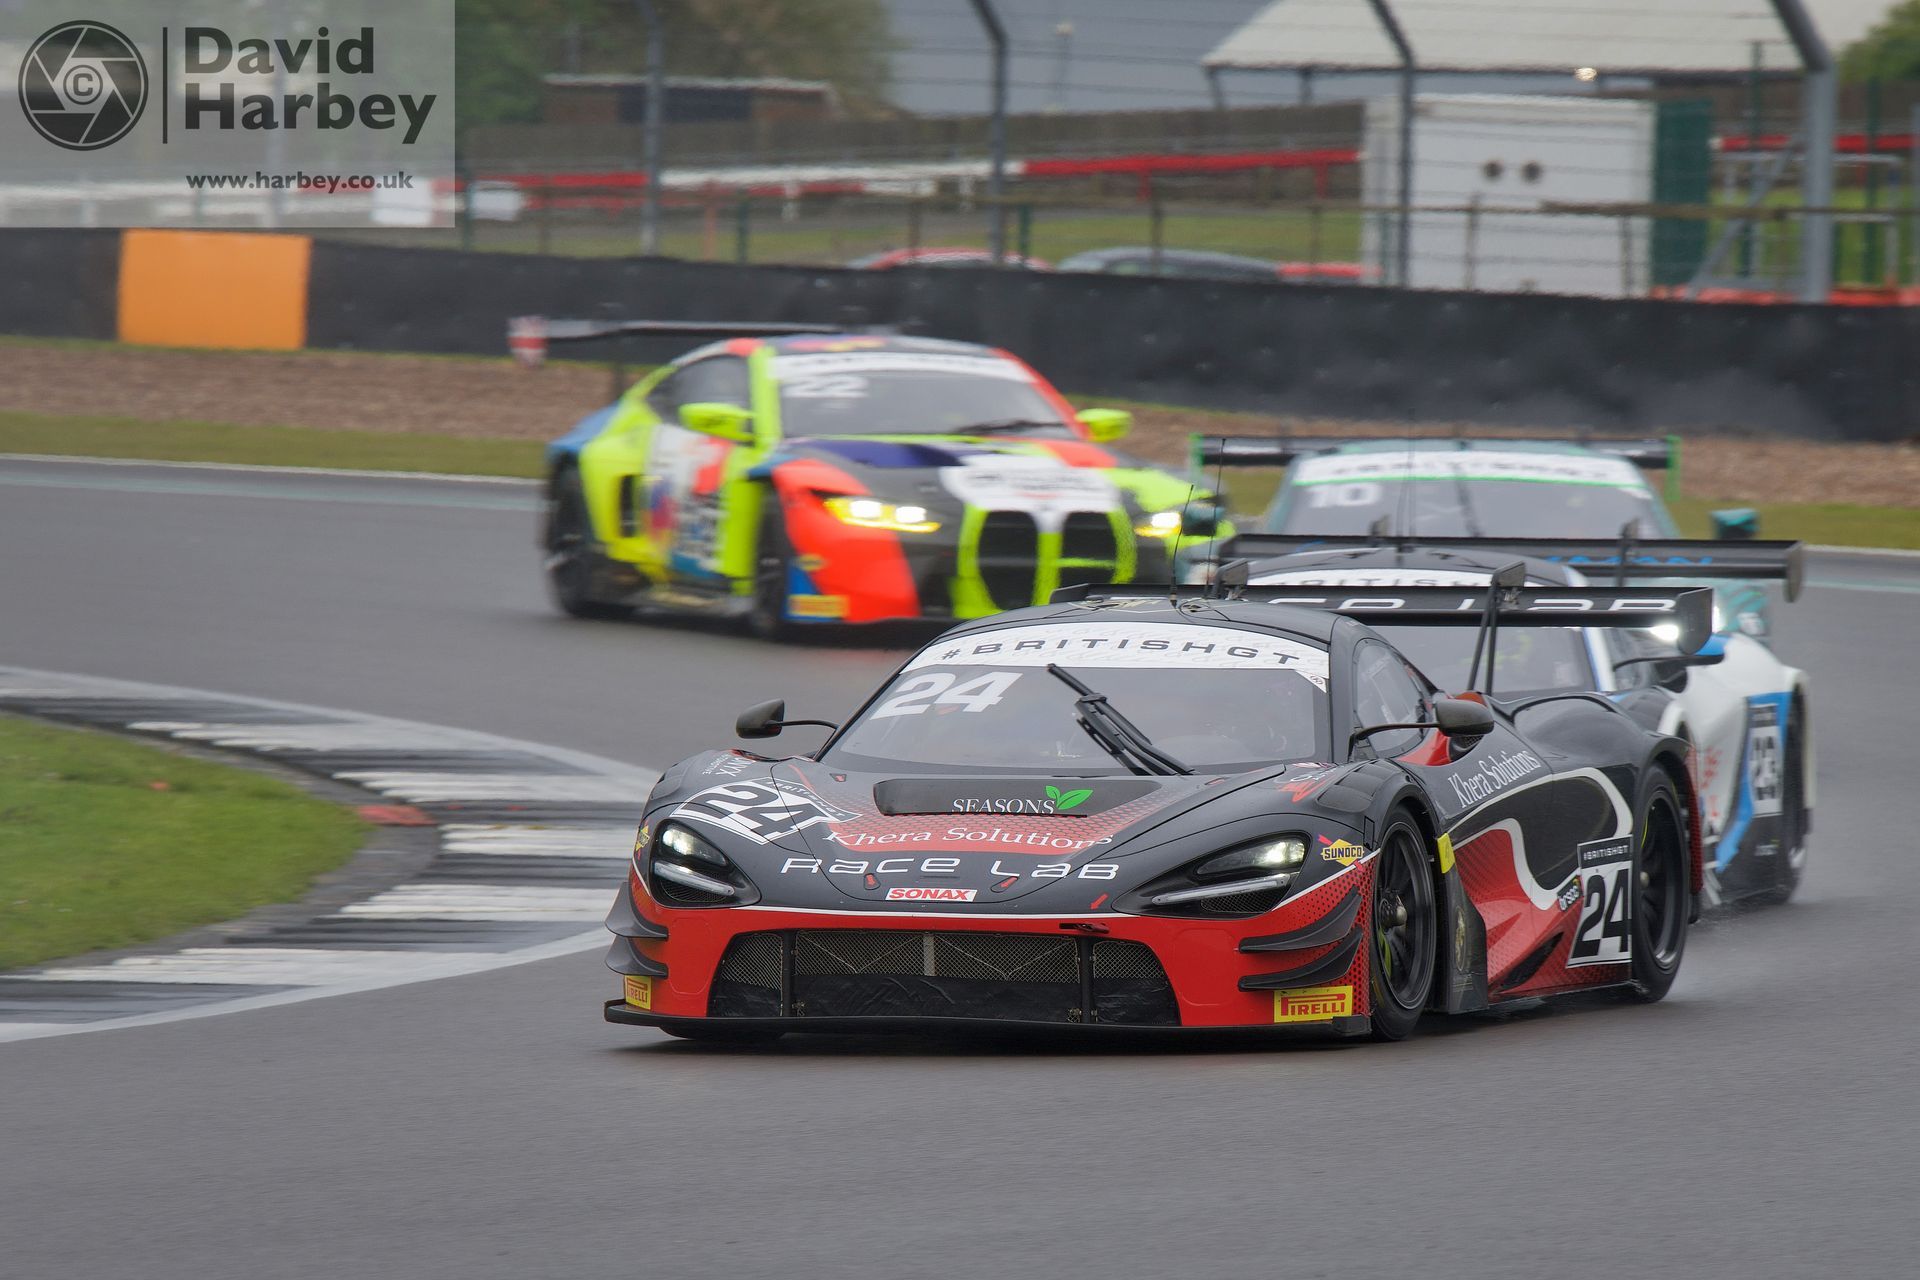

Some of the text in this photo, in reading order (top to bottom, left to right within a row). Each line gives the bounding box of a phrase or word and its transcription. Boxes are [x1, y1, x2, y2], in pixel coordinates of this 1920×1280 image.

[1308, 484, 1382, 507] 10
[942, 638, 1300, 666] #BRITISHGT
[869, 671, 1023, 720] 24
[1448, 750, 1542, 808] Khera Solutions
[681, 784, 830, 839] 24
[951, 798, 1055, 815] SEASONS
[823, 826, 1114, 850] Khera Solutions
[1323, 846, 1363, 859] SUNOCO
[888, 887, 970, 901] SONAX
[1571, 868, 1633, 959] 24
[1280, 993, 1347, 1017] PIRELLI
